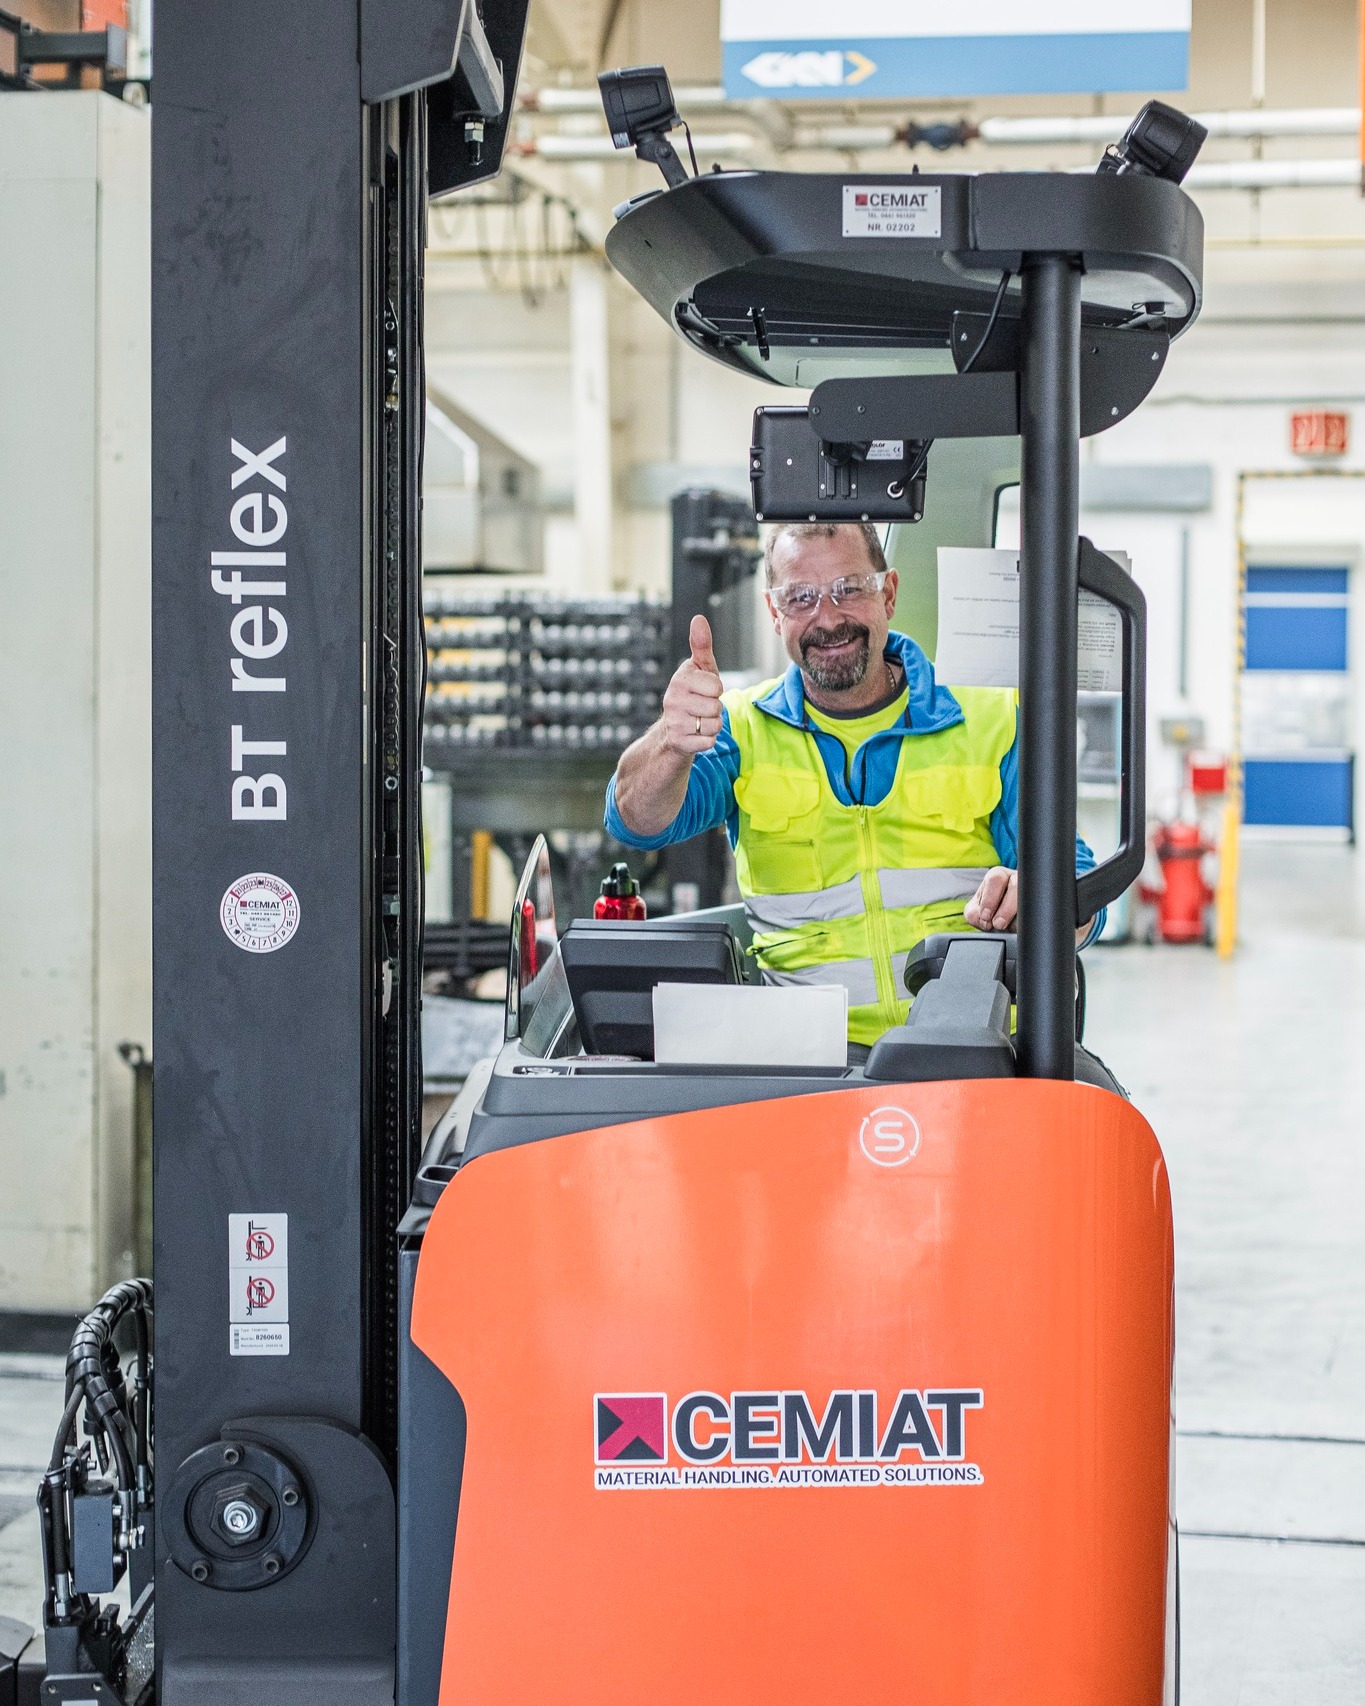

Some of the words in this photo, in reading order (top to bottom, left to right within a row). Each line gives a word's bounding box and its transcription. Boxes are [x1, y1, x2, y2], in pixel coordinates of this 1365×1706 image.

[870, 193, 928, 207] CEMIAT
[886, 223, 915, 231] 02202
[211, 436, 288, 692] reflex
[231, 724, 287, 820] BT
[248, 901, 280, 909] CEMIAT
[674, 1391, 981, 1461] CEMIAT
[597, 1471, 680, 1485] MATERIAL
[684, 1470, 774, 1485] HANDLING.
[778, 1468, 880, 1484] AUTOMATED
[884, 1467, 981, 1482] SOLUTIONS.
